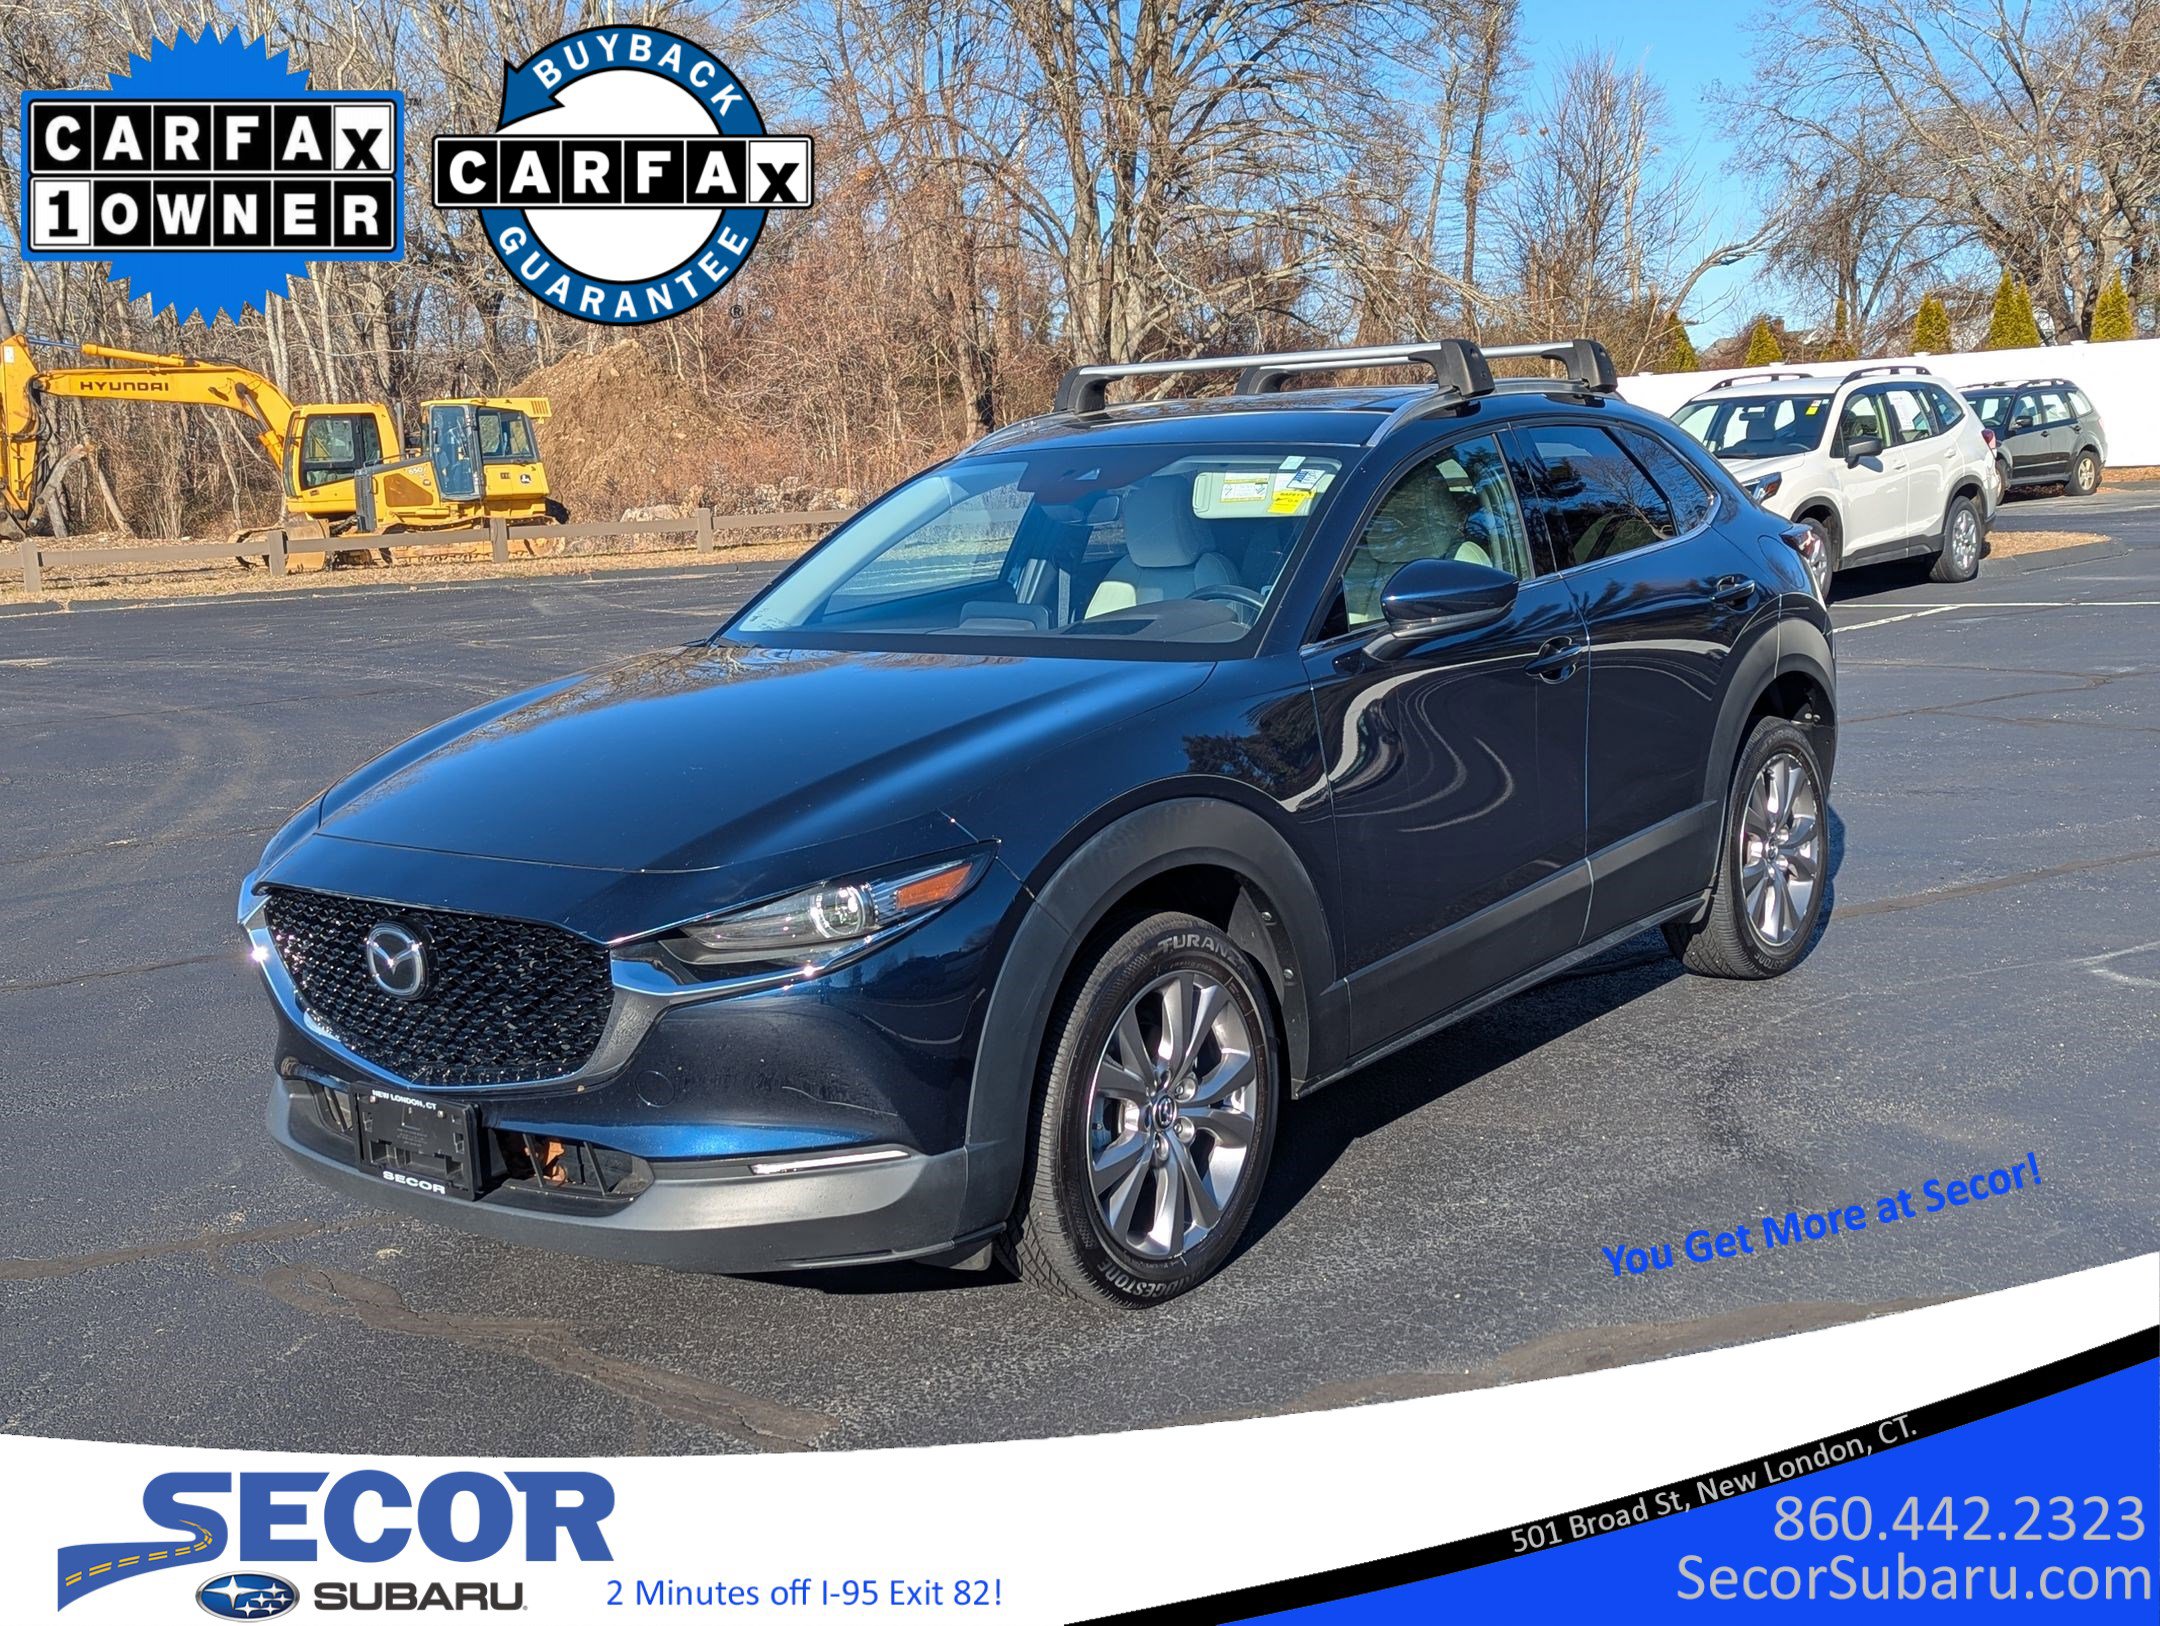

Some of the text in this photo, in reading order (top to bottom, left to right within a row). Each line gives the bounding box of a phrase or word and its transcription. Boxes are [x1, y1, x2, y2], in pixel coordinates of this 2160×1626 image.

[80, 381, 169, 391] HYUNDAI
[372, 1089, 389, 1099] NEW
[426, 1102, 437, 1110] CT
[383, 1170, 446, 1195] SECOR
